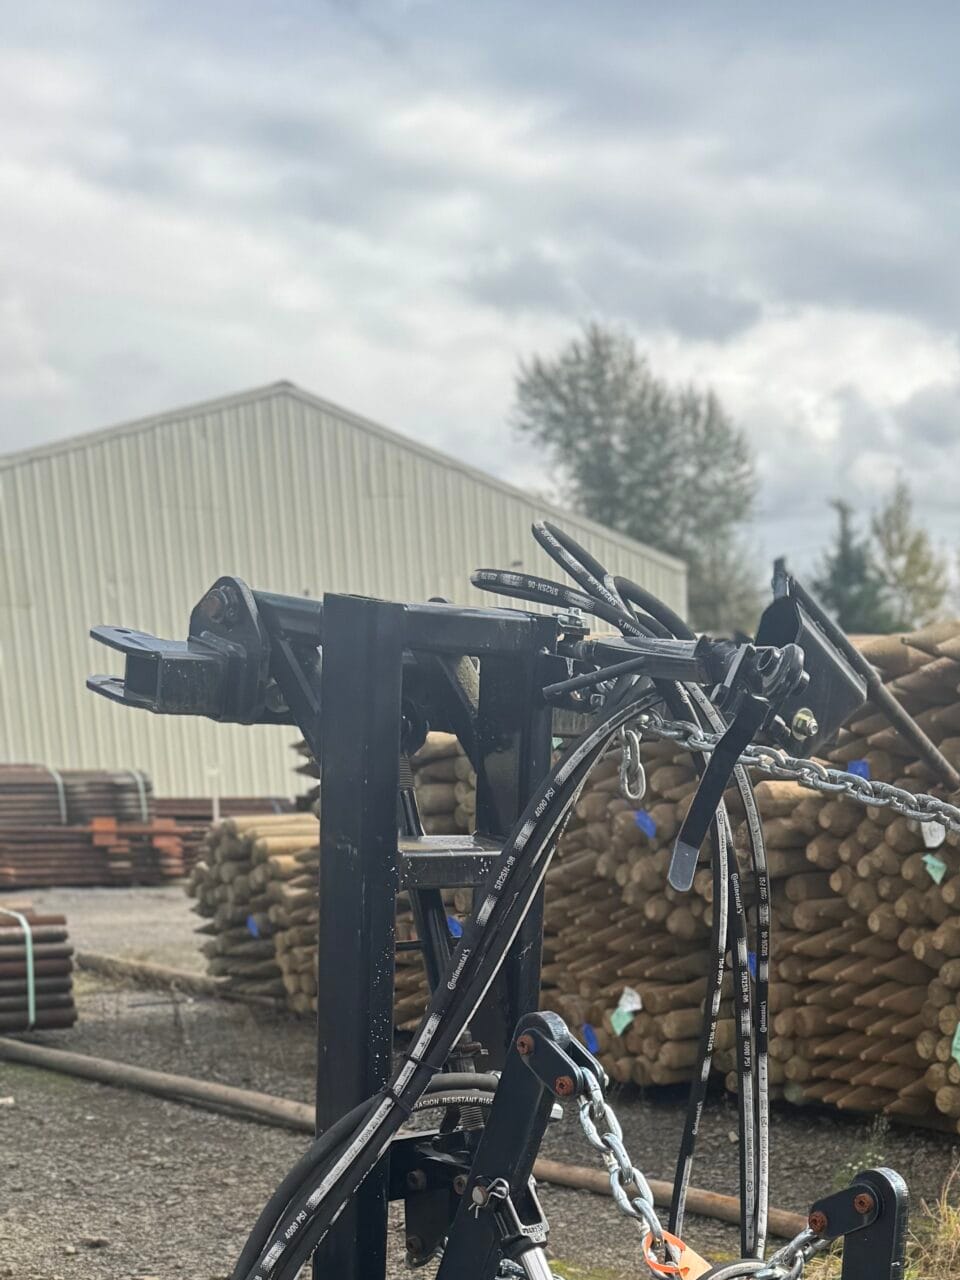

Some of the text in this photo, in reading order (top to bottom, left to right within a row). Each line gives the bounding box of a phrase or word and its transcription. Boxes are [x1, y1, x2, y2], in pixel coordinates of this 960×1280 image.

[534, 787, 557, 818] 4000 PSI
[494, 855, 516, 891] SR2SN-08
[447, 953, 470, 991] Continental
[442, 1096, 478, 1105] RESISTANT
[284, 1210, 308, 1240] 4000 PSI
